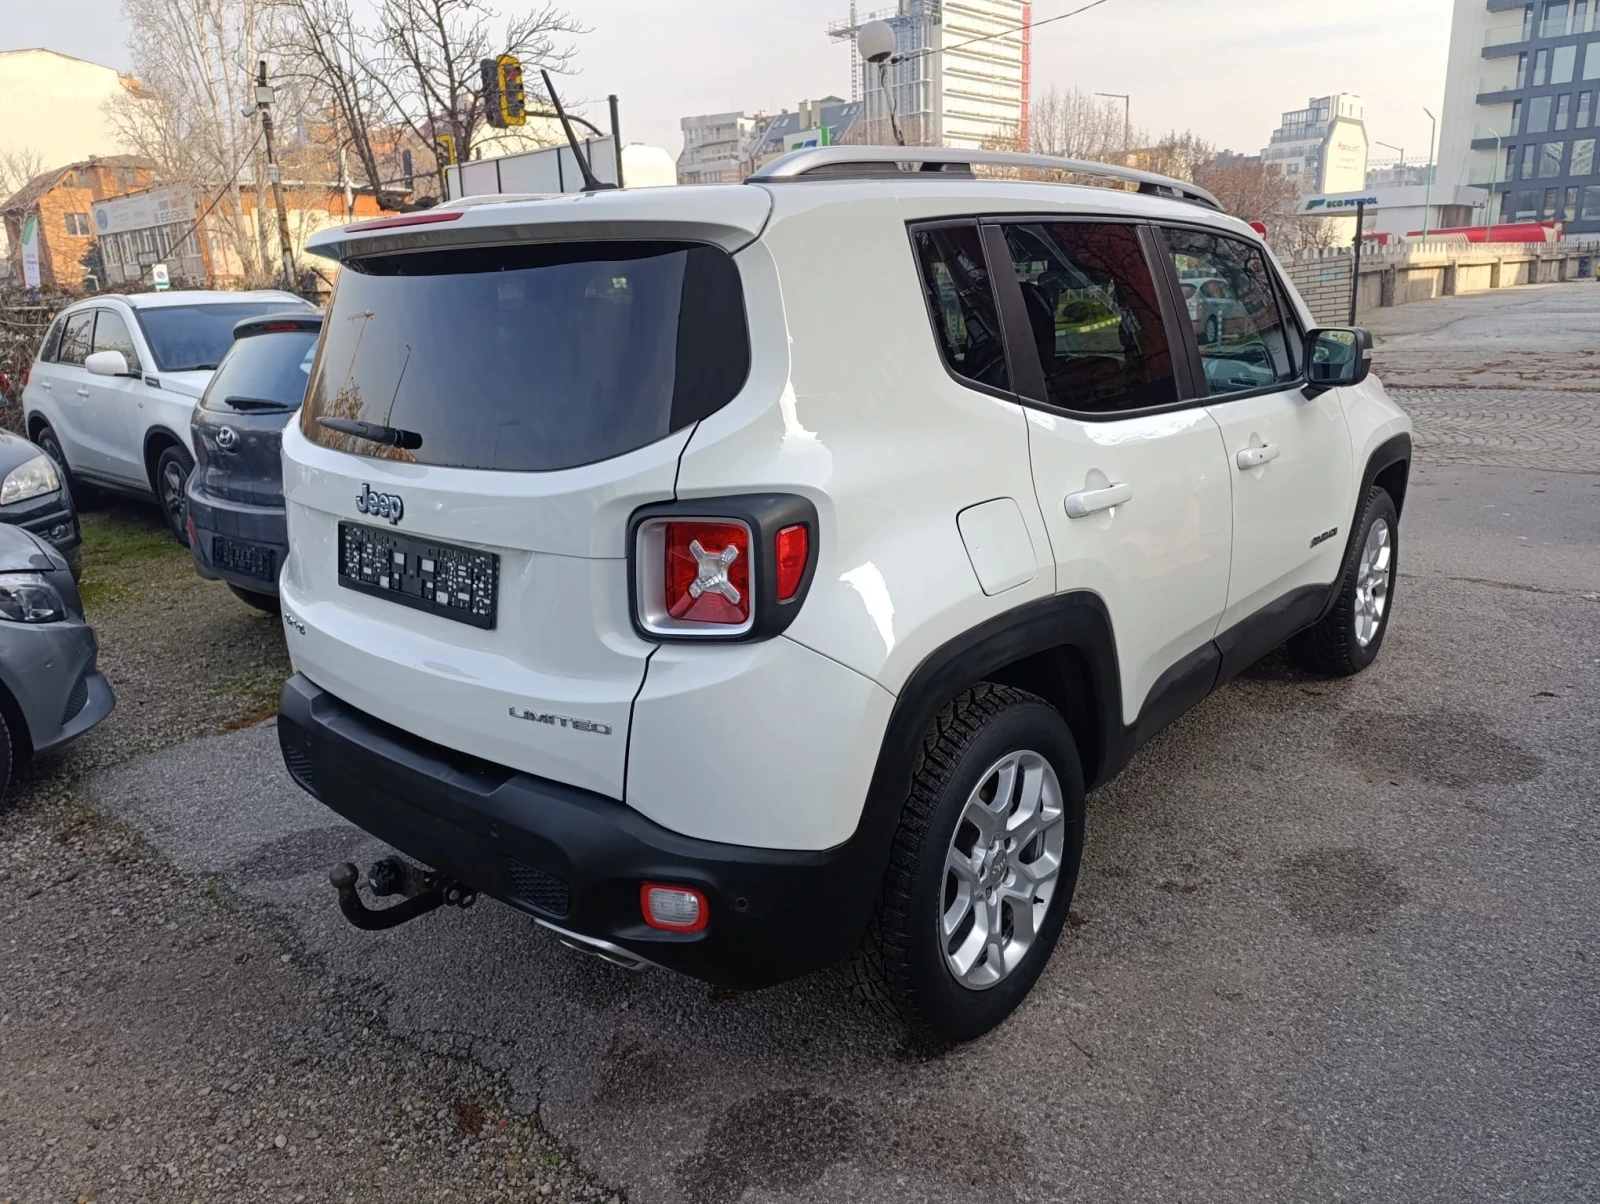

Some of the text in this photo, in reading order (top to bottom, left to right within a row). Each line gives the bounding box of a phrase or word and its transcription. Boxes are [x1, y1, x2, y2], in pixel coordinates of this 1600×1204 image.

[1326, 199, 1343, 208] ECO
[355, 482, 404, 526] Jeep
[508, 705, 612, 735] LIMITED
